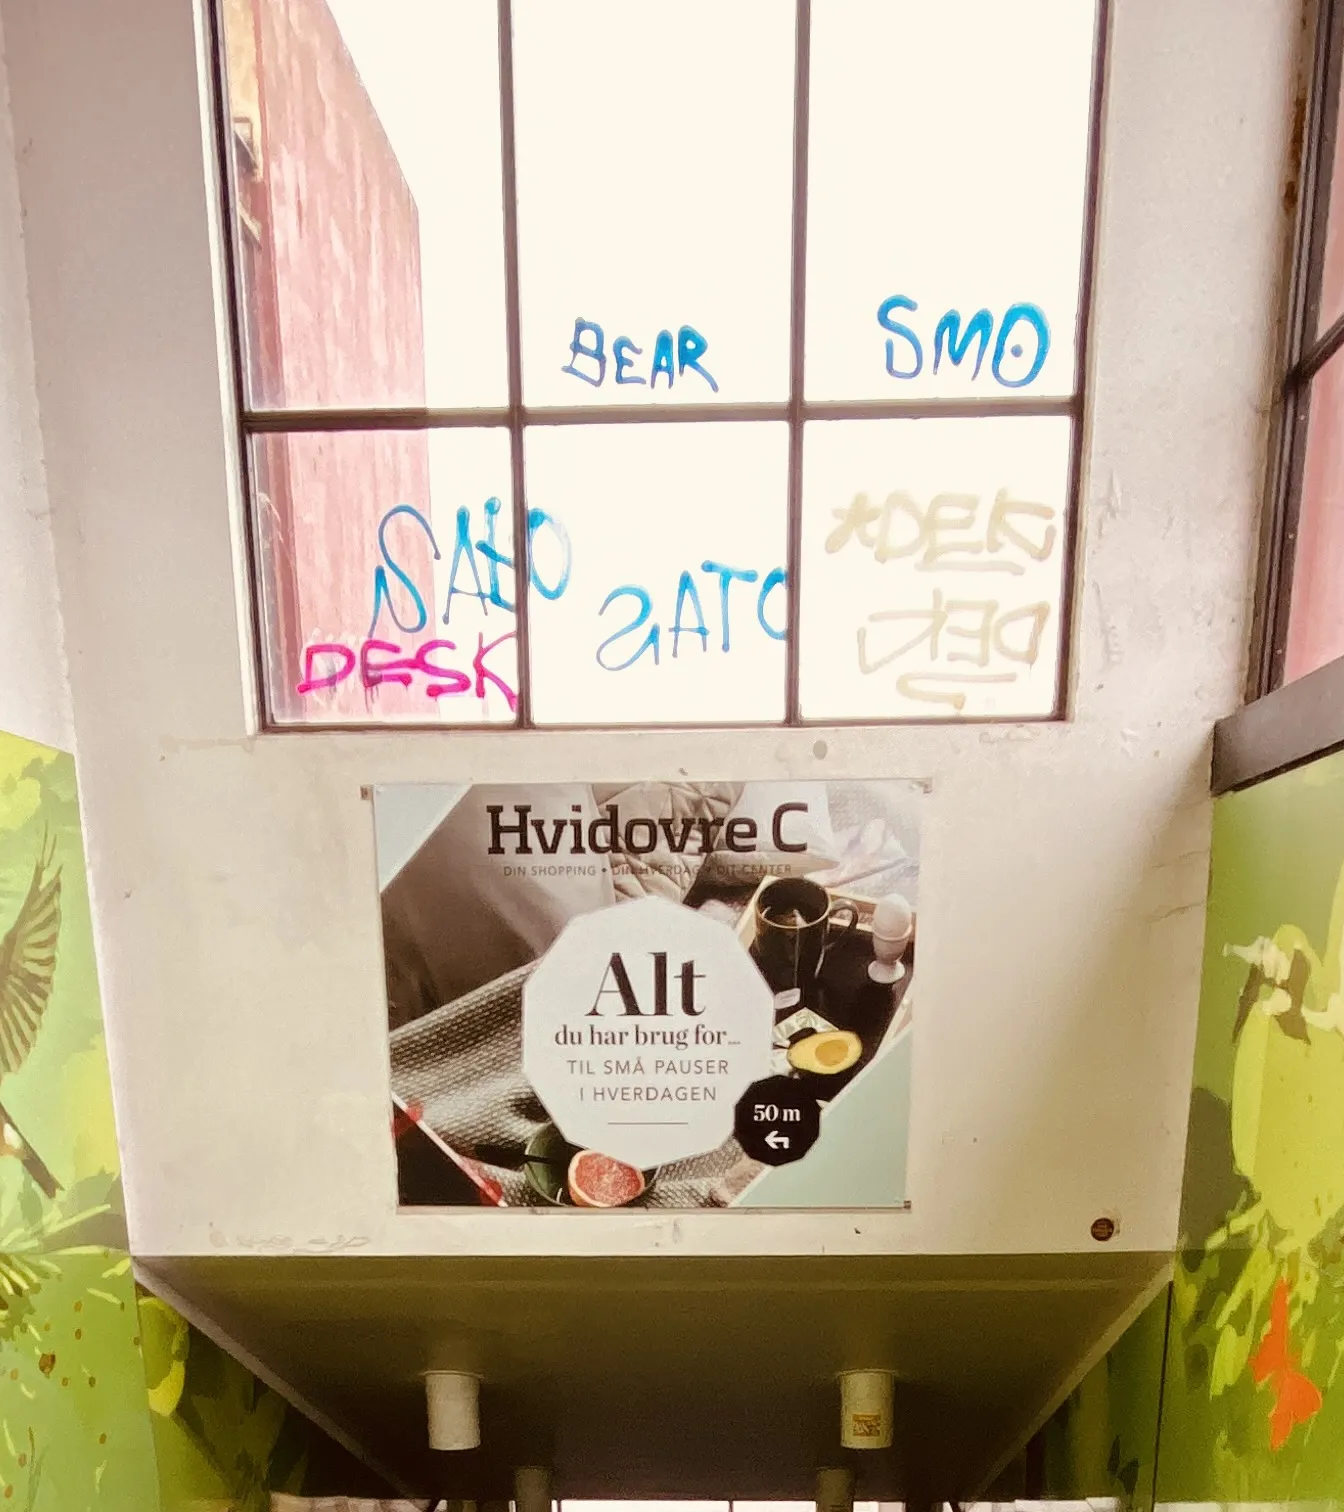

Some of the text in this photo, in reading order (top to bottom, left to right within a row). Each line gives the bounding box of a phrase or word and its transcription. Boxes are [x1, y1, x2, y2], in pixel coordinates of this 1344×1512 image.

[561, 317, 719, 393] BEAR
[877, 294, 1052, 388] SMO
[297, 631, 519, 713] DESK
[486, 802, 809, 855] Hvidovre C
[531, 865, 596, 877] SHOPPING
[584, 951, 707, 1017] Alt
[554, 1024, 582, 1046] du
[590, 1025, 629, 1046] har
[635, 1024, 689, 1051] brug
[567, 1057, 730, 1075] TIL SMÅ PAUSER
[593, 1087, 717, 1102] HVERDAGEN
[753, 1104, 801, 1122] 50 m
